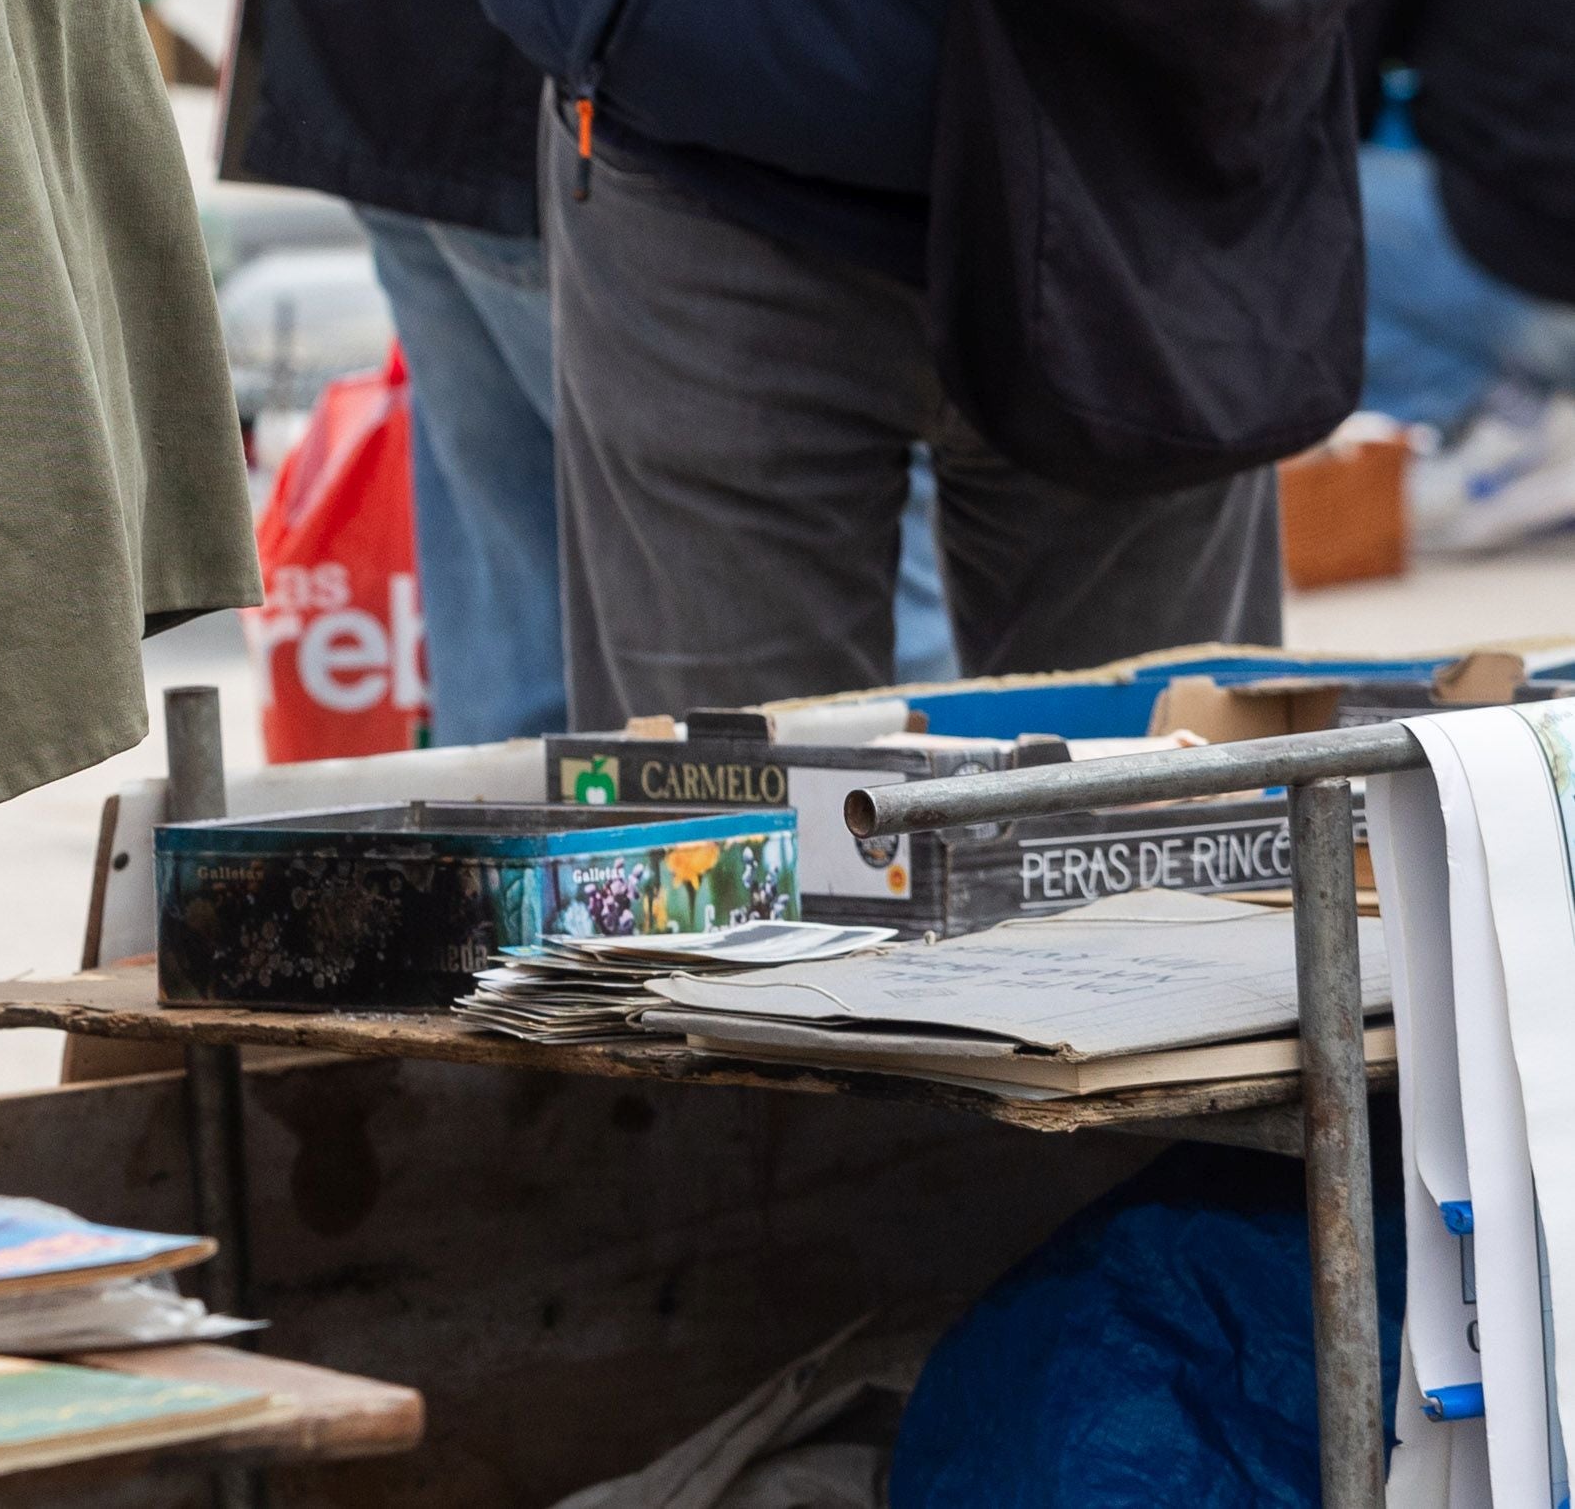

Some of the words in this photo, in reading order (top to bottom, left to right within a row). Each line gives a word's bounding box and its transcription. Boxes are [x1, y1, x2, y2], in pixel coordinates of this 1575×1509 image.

[641, 760, 787, 804] CARMELO
[573, 866, 625, 884] Galletas
[1019, 843, 1132, 901] PERAS
[1139, 840, 1185, 888] DE
